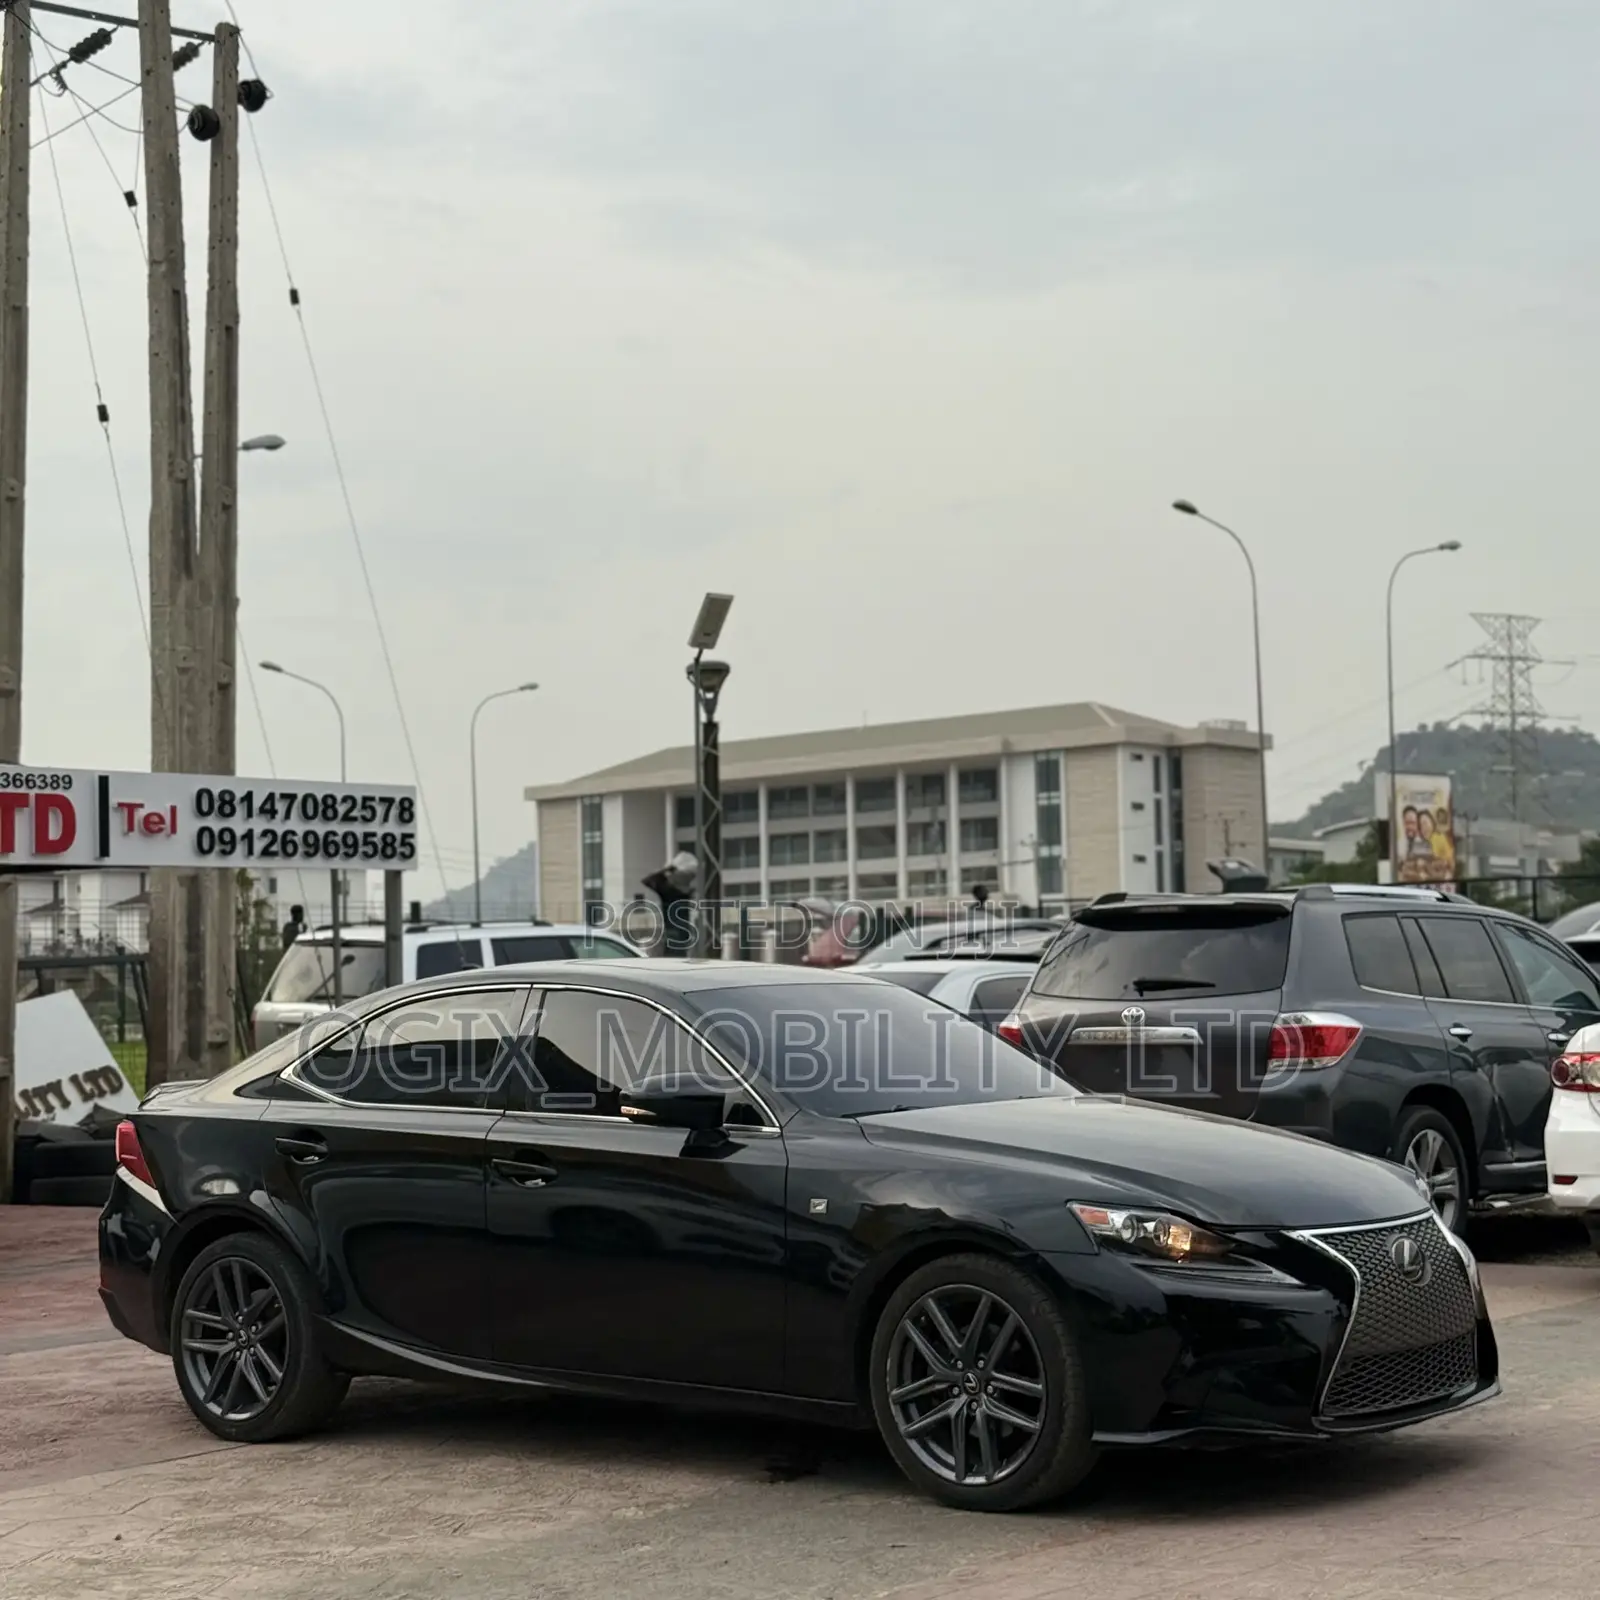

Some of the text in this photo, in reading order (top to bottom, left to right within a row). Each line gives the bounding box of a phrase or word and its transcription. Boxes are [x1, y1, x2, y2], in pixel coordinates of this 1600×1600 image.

[0, 772, 72, 790] 366389
[0, 792, 76, 854] TD
[117, 802, 177, 835] Tel
[195, 788, 415, 824] 08147082578
[196, 826, 416, 860] 09126969585
[68, 1065, 123, 1103] LTD
